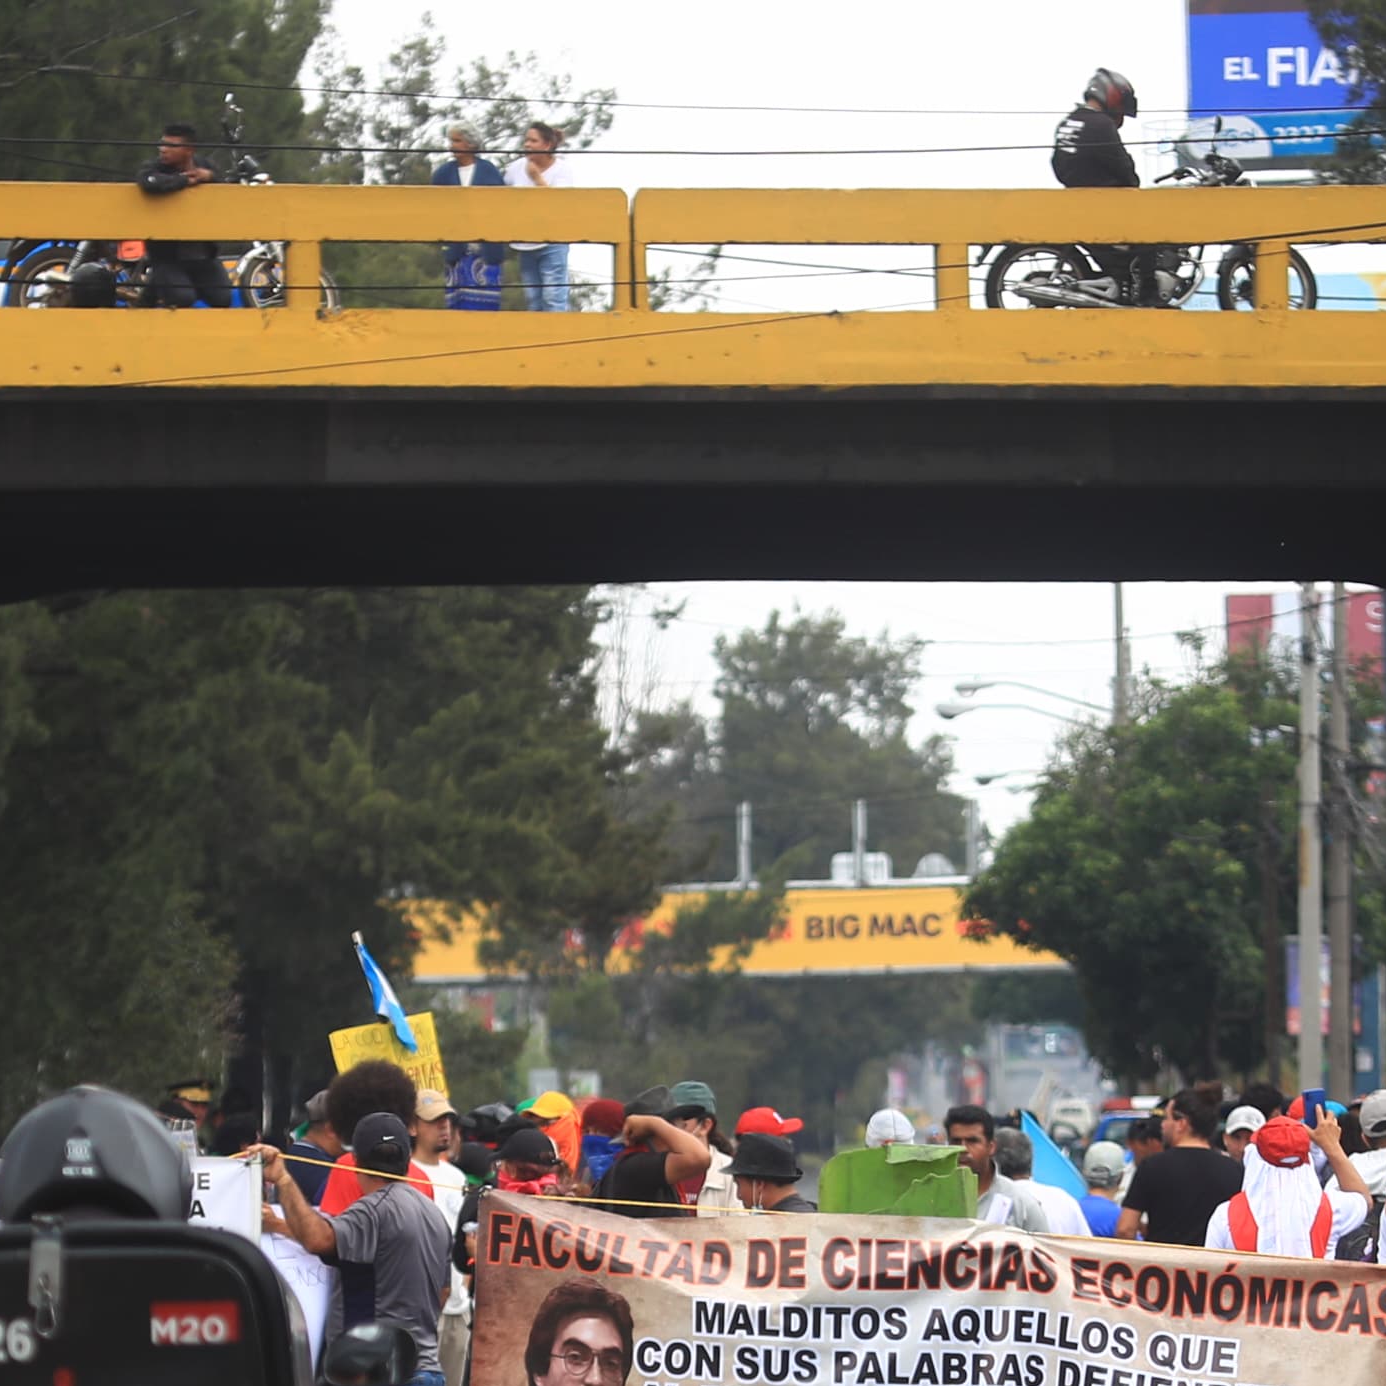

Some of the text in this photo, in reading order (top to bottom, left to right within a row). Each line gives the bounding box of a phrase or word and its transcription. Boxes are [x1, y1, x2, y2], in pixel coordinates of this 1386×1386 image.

[1224, 46, 1360, 87] EL FIA
[805, 913, 941, 940] BIG MAC
[487, 1210, 733, 1287] FACULTAD
[745, 1237, 809, 1290] DE
[821, 1236, 1058, 1295] CIENCIAS
[694, 1300, 1238, 1374] MALDITOS AQUELLOS QUE
[635, 1340, 722, 1378] CON
[734, 1346, 818, 1383] SUS
